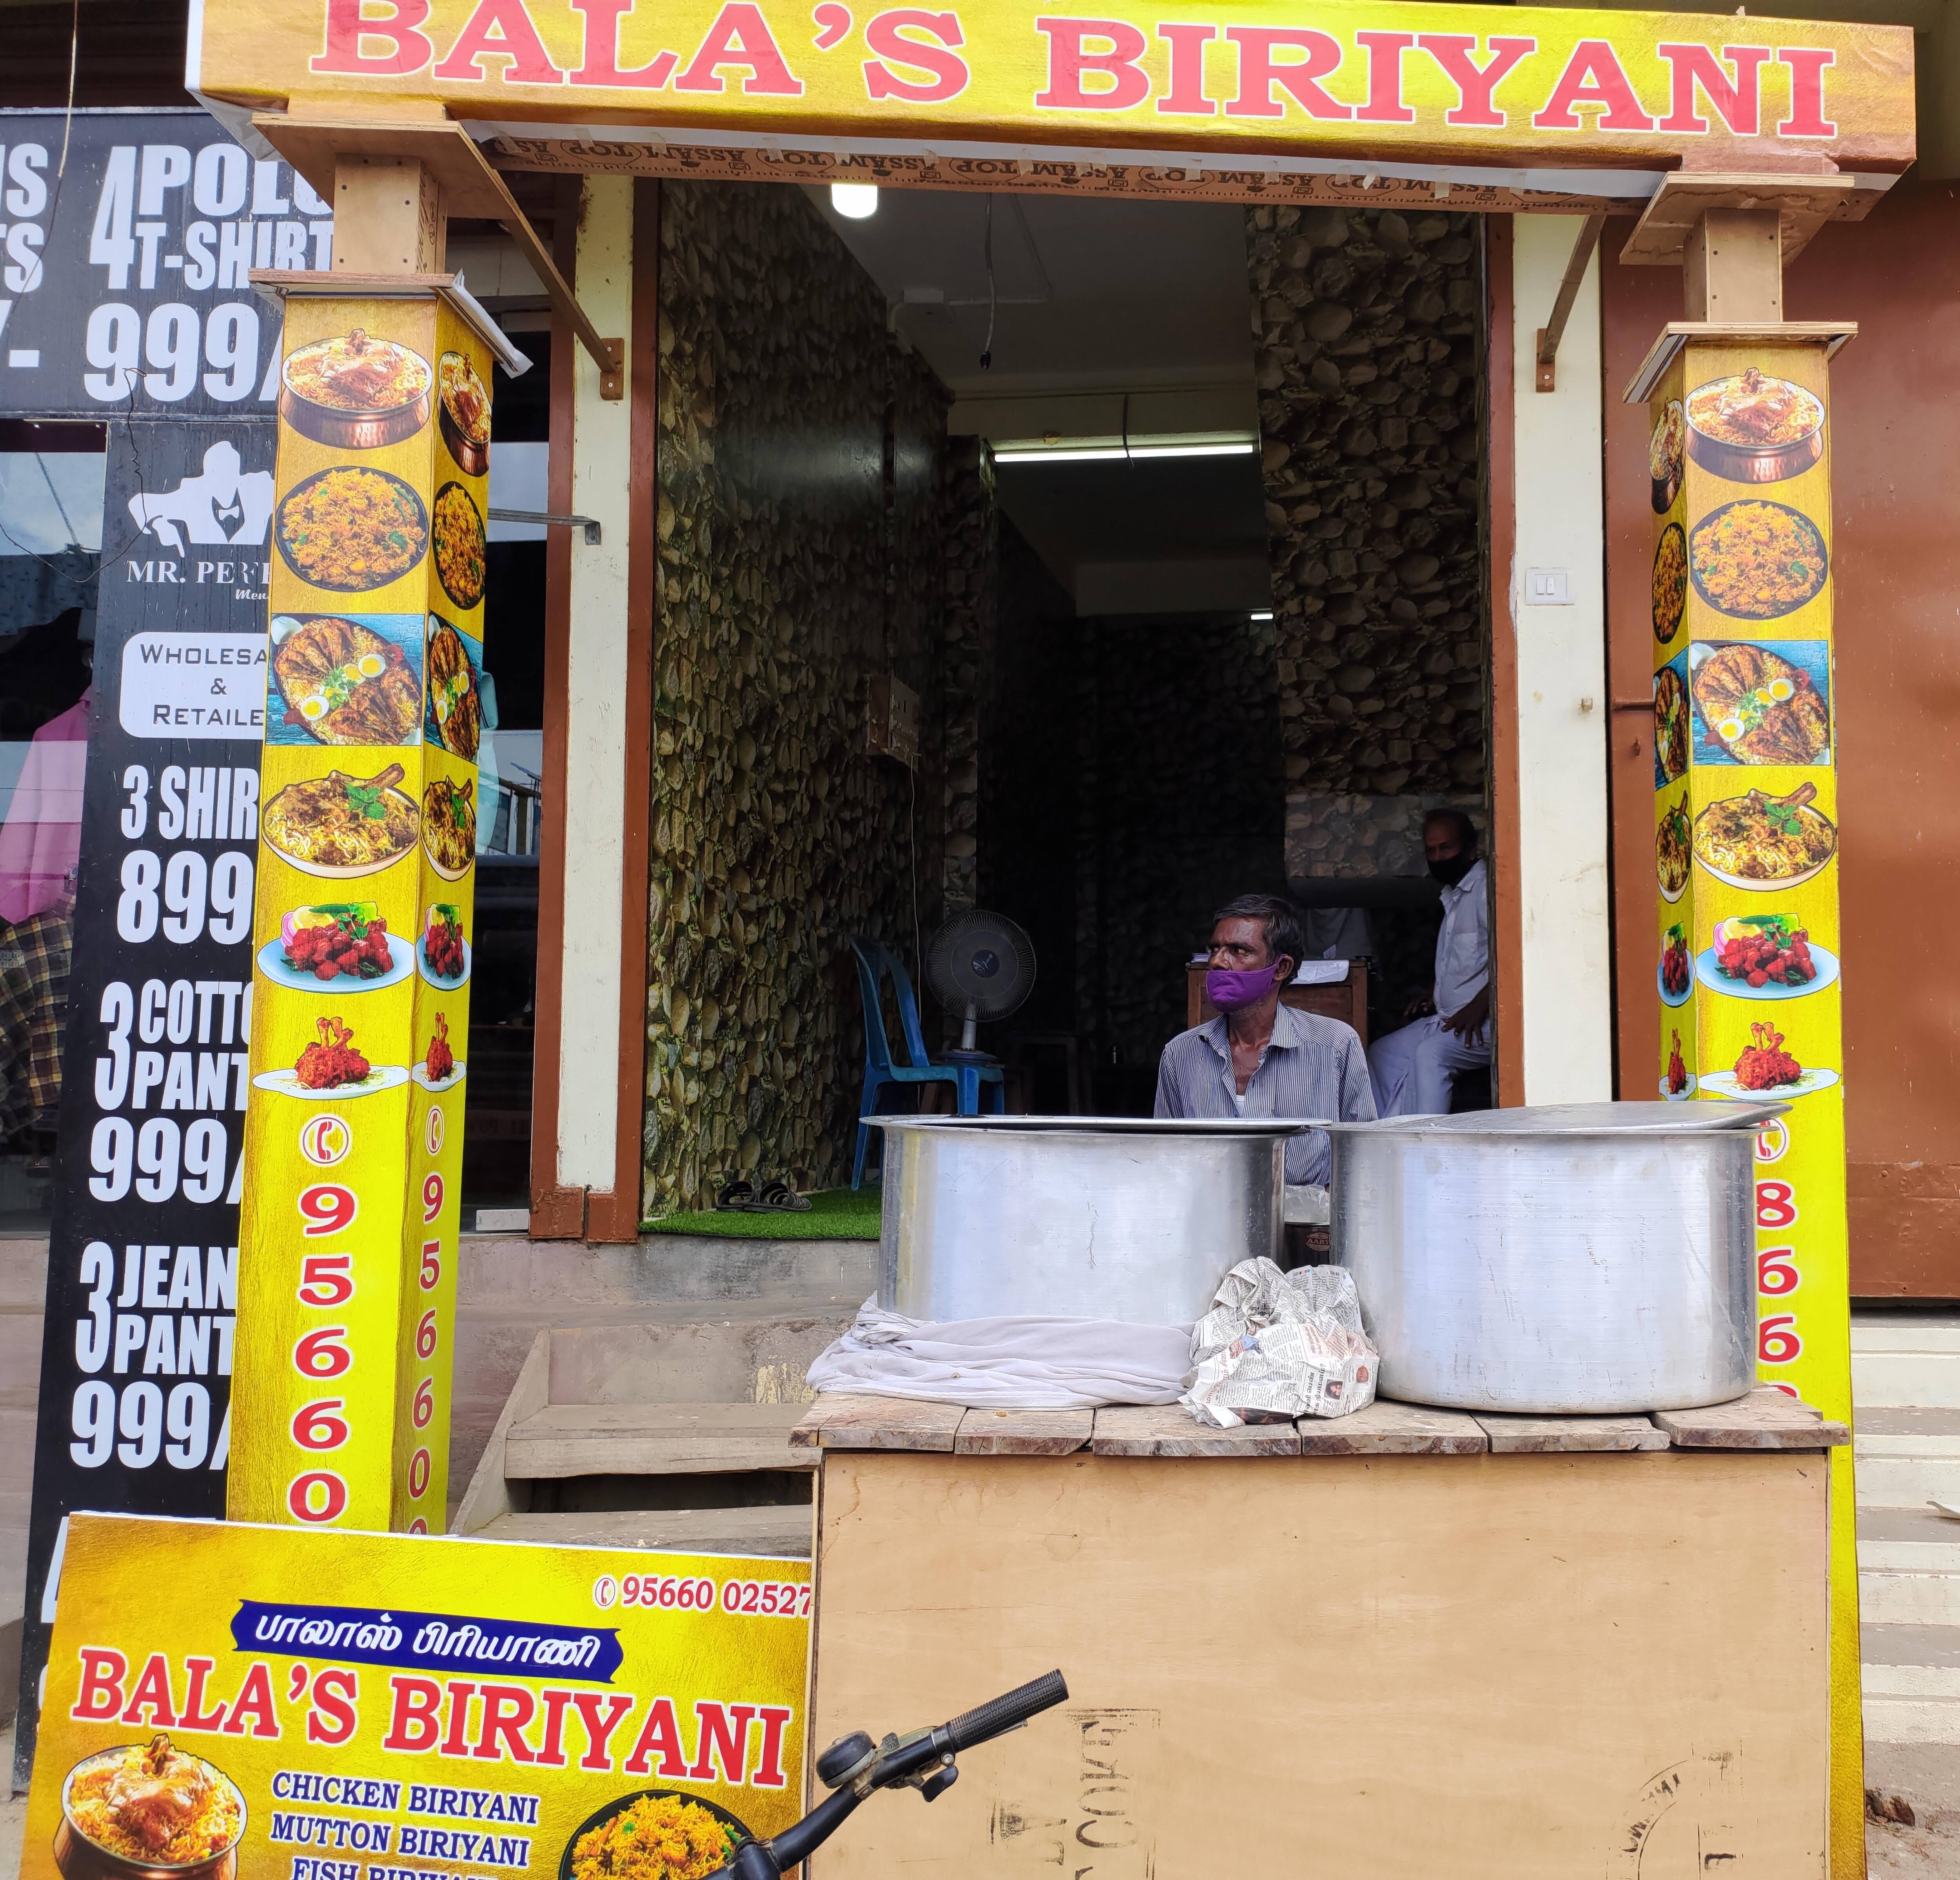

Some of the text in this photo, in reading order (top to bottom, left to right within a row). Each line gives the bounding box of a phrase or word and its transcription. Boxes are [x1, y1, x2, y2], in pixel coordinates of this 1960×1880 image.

[312, 0, 1836, 137] BALA'S BIRIYANI
[569, 144, 633, 157] TOP
[956, 160, 1018, 174] TOP
[1403, 179, 1496, 194] ASSM
[90, 146, 136, 289] 4
[125, 560, 185, 583] MR.
[210, 678, 227, 695] &
[121, 765, 149, 840] 3
[139, 979, 254, 1045] COTT
[94, 982, 134, 1111] 3
[75, 1241, 114, 1374] 3
[622, 1577, 810, 1615] 95660 02527
[256, 1612, 601, 1668] பாலாஸ் பிரியாணி
[72, 1649, 356, 1744] BALA'S
[384, 1677, 790, 1786] BIRIYANI
[272, 1772, 539, 1824] CHICKEN BIRIYANI
[270, 1814, 529, 1867] MUTTON BIRIYANI
[292, 1858, 359, 1880] FISH
